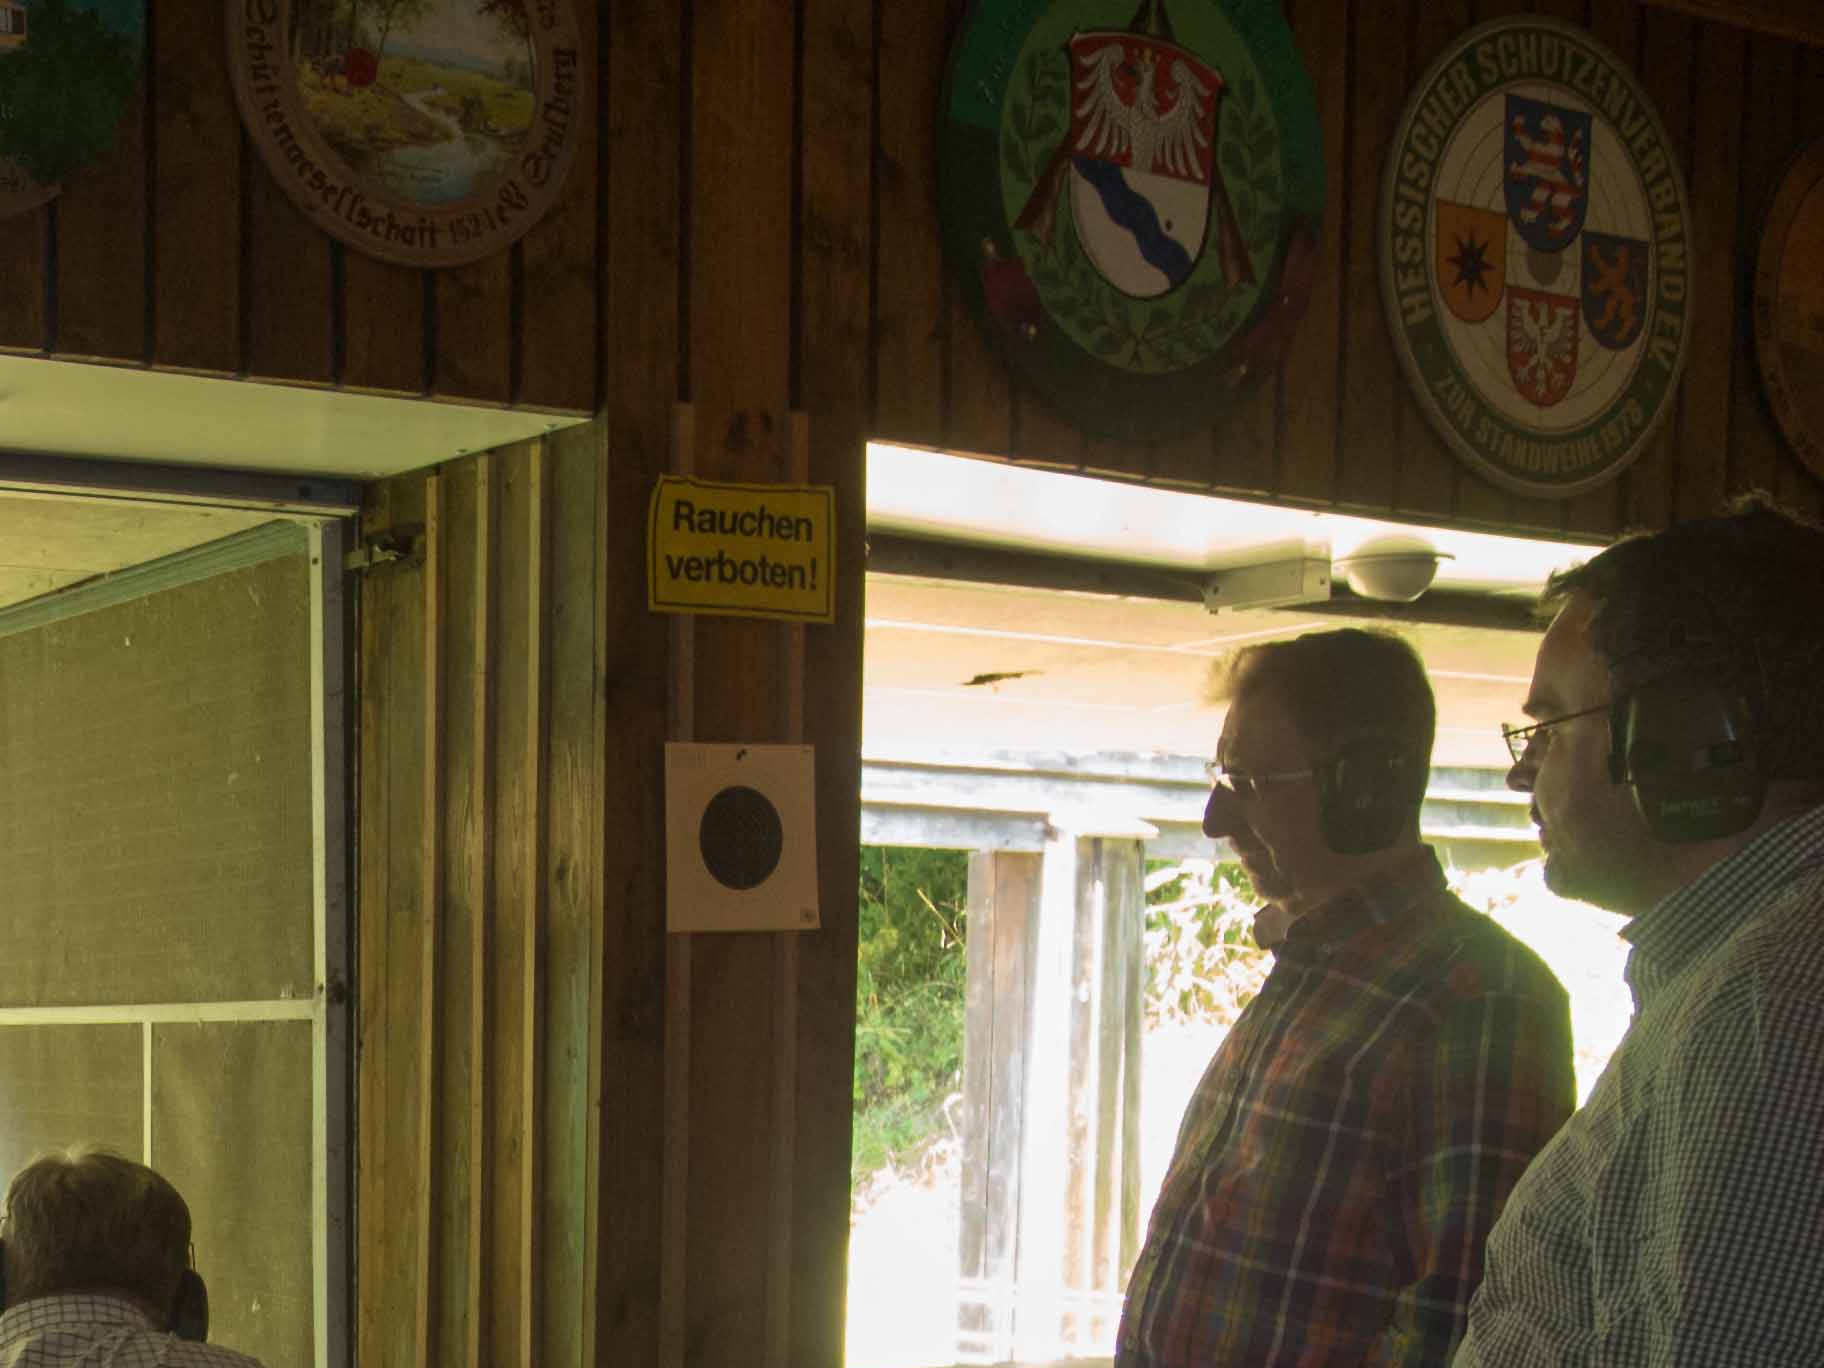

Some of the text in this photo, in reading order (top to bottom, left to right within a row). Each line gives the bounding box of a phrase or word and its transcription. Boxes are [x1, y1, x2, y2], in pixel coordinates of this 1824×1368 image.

[1392, 58, 1479, 326] HESSISCHER
[672, 498, 814, 543] Rauchen
[664, 549, 819, 591] verboten!
